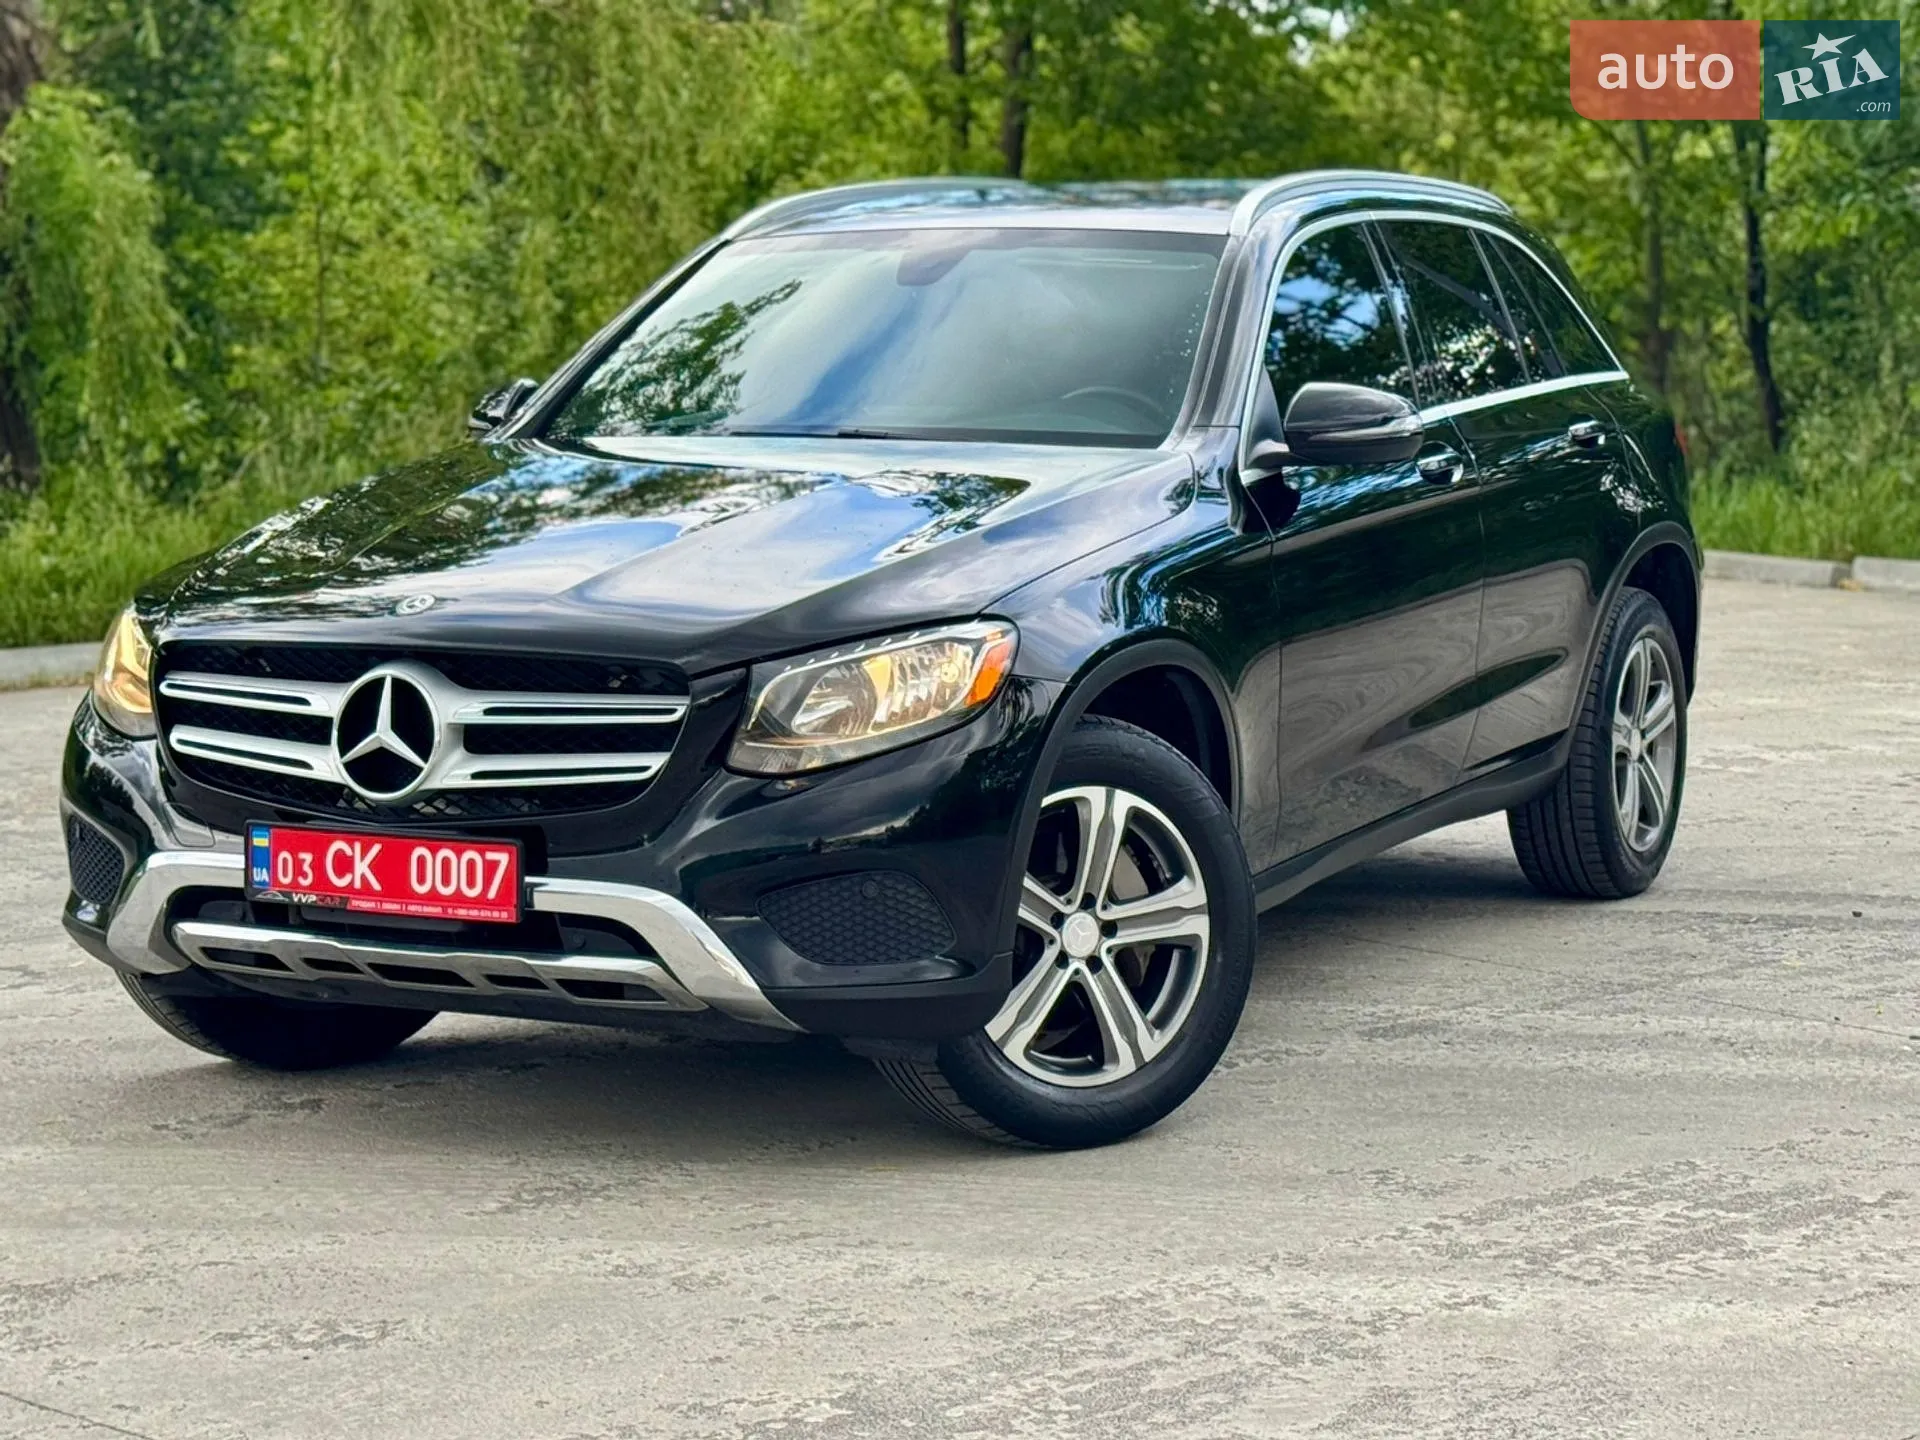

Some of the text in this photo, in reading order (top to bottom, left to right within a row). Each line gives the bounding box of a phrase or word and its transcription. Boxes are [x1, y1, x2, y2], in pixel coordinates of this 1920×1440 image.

[253, 867, 270, 882] UA
[277, 840, 510, 900] 03 CK 0007
